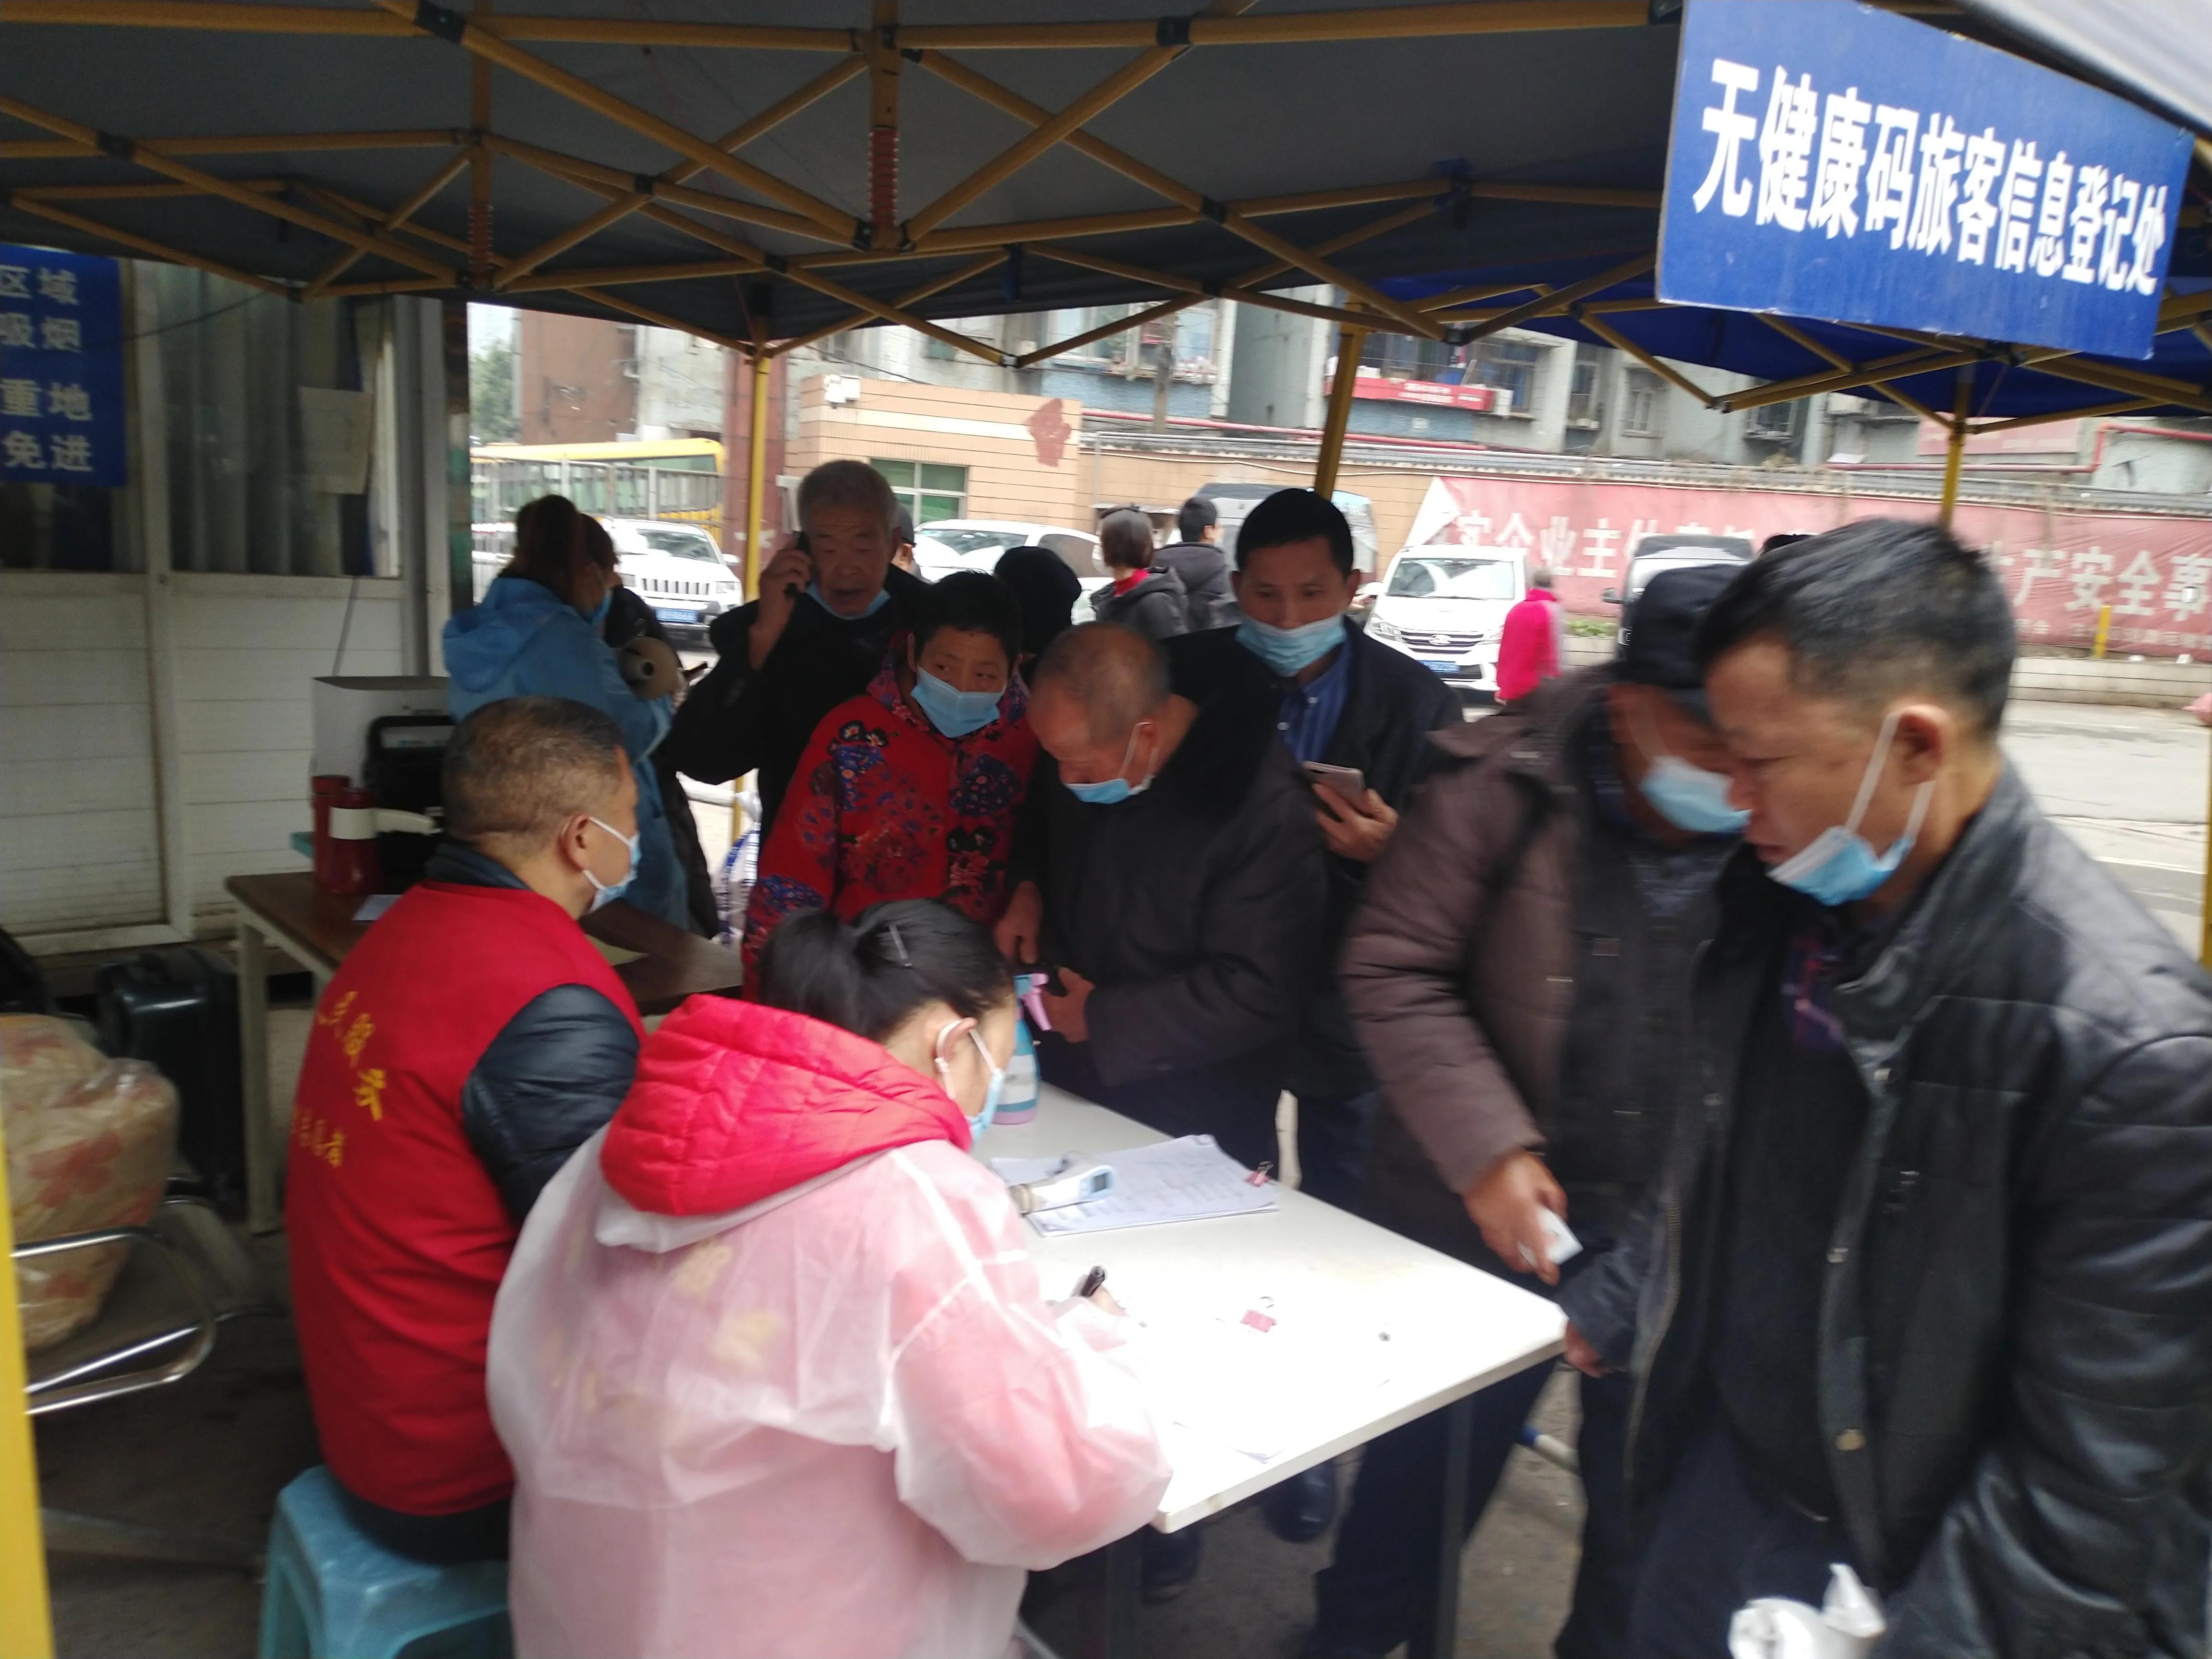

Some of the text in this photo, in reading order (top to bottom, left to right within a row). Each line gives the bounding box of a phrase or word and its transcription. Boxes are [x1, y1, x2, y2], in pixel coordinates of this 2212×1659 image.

[1692, 58, 2168, 296] 无健康码旅客信息登记处
[0, 264, 79, 305] 区域
[0, 378, 93, 421] 重地
[1, 431, 94, 472] 免进
